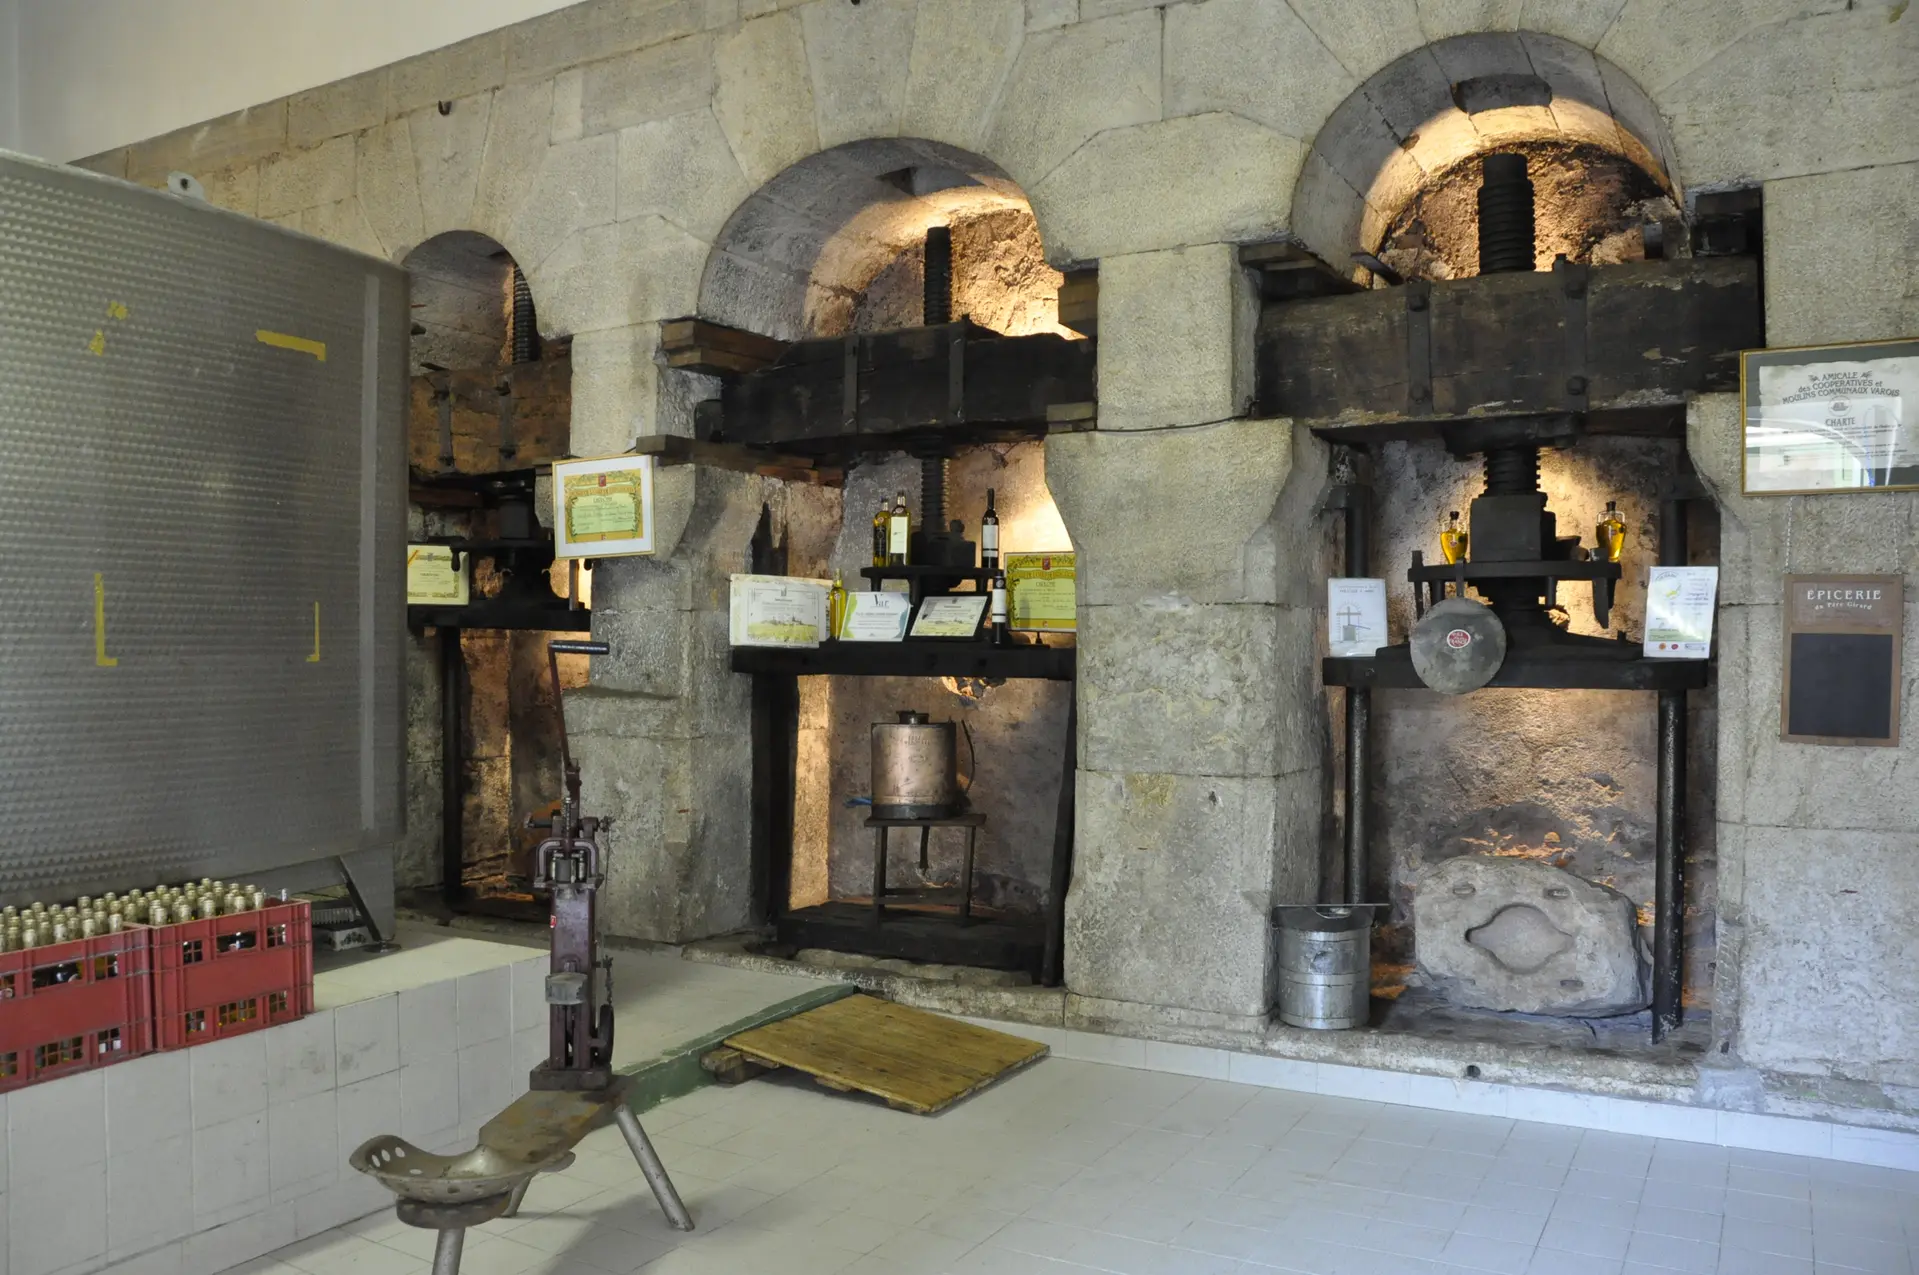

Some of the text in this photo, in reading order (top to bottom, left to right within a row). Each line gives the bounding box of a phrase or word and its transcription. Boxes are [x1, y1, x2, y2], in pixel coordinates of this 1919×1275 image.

[1822, 372, 1858, 381] AMICALE
[1782, 387, 1900, 404] MOULINS COMMUNAUX VAROIS
[1825, 417, 1856, 426] CHARTE
